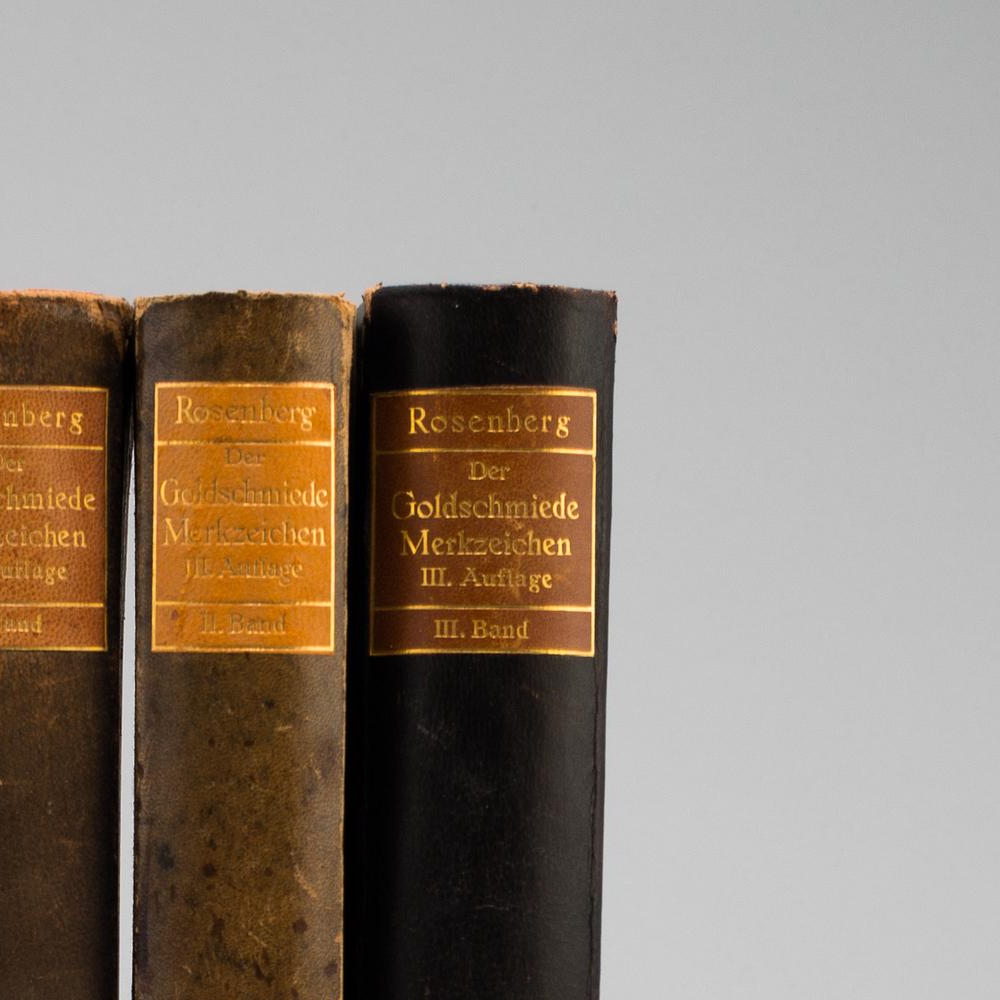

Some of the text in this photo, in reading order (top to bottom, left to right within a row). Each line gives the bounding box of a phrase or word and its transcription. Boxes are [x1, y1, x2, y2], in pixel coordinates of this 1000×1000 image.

[176, 395, 316, 431] Rosenberg
[408, 405, 570, 438] Rosenberg
[224, 448, 266, 467] Der
[468, 461, 510, 481] Der
[160, 478, 328, 507] Goldschmiede
[392, 490, 579, 520] Goldschmiede
[164, 518, 326, 546] Merkzeichen
[400, 529, 572, 556] Merkzeichen
[220, 557, 303, 586] Auflage
[420, 567, 552, 593] III. Auflage
[229, 612, 286, 634] Band
[434, 619, 529, 639] III. Band
